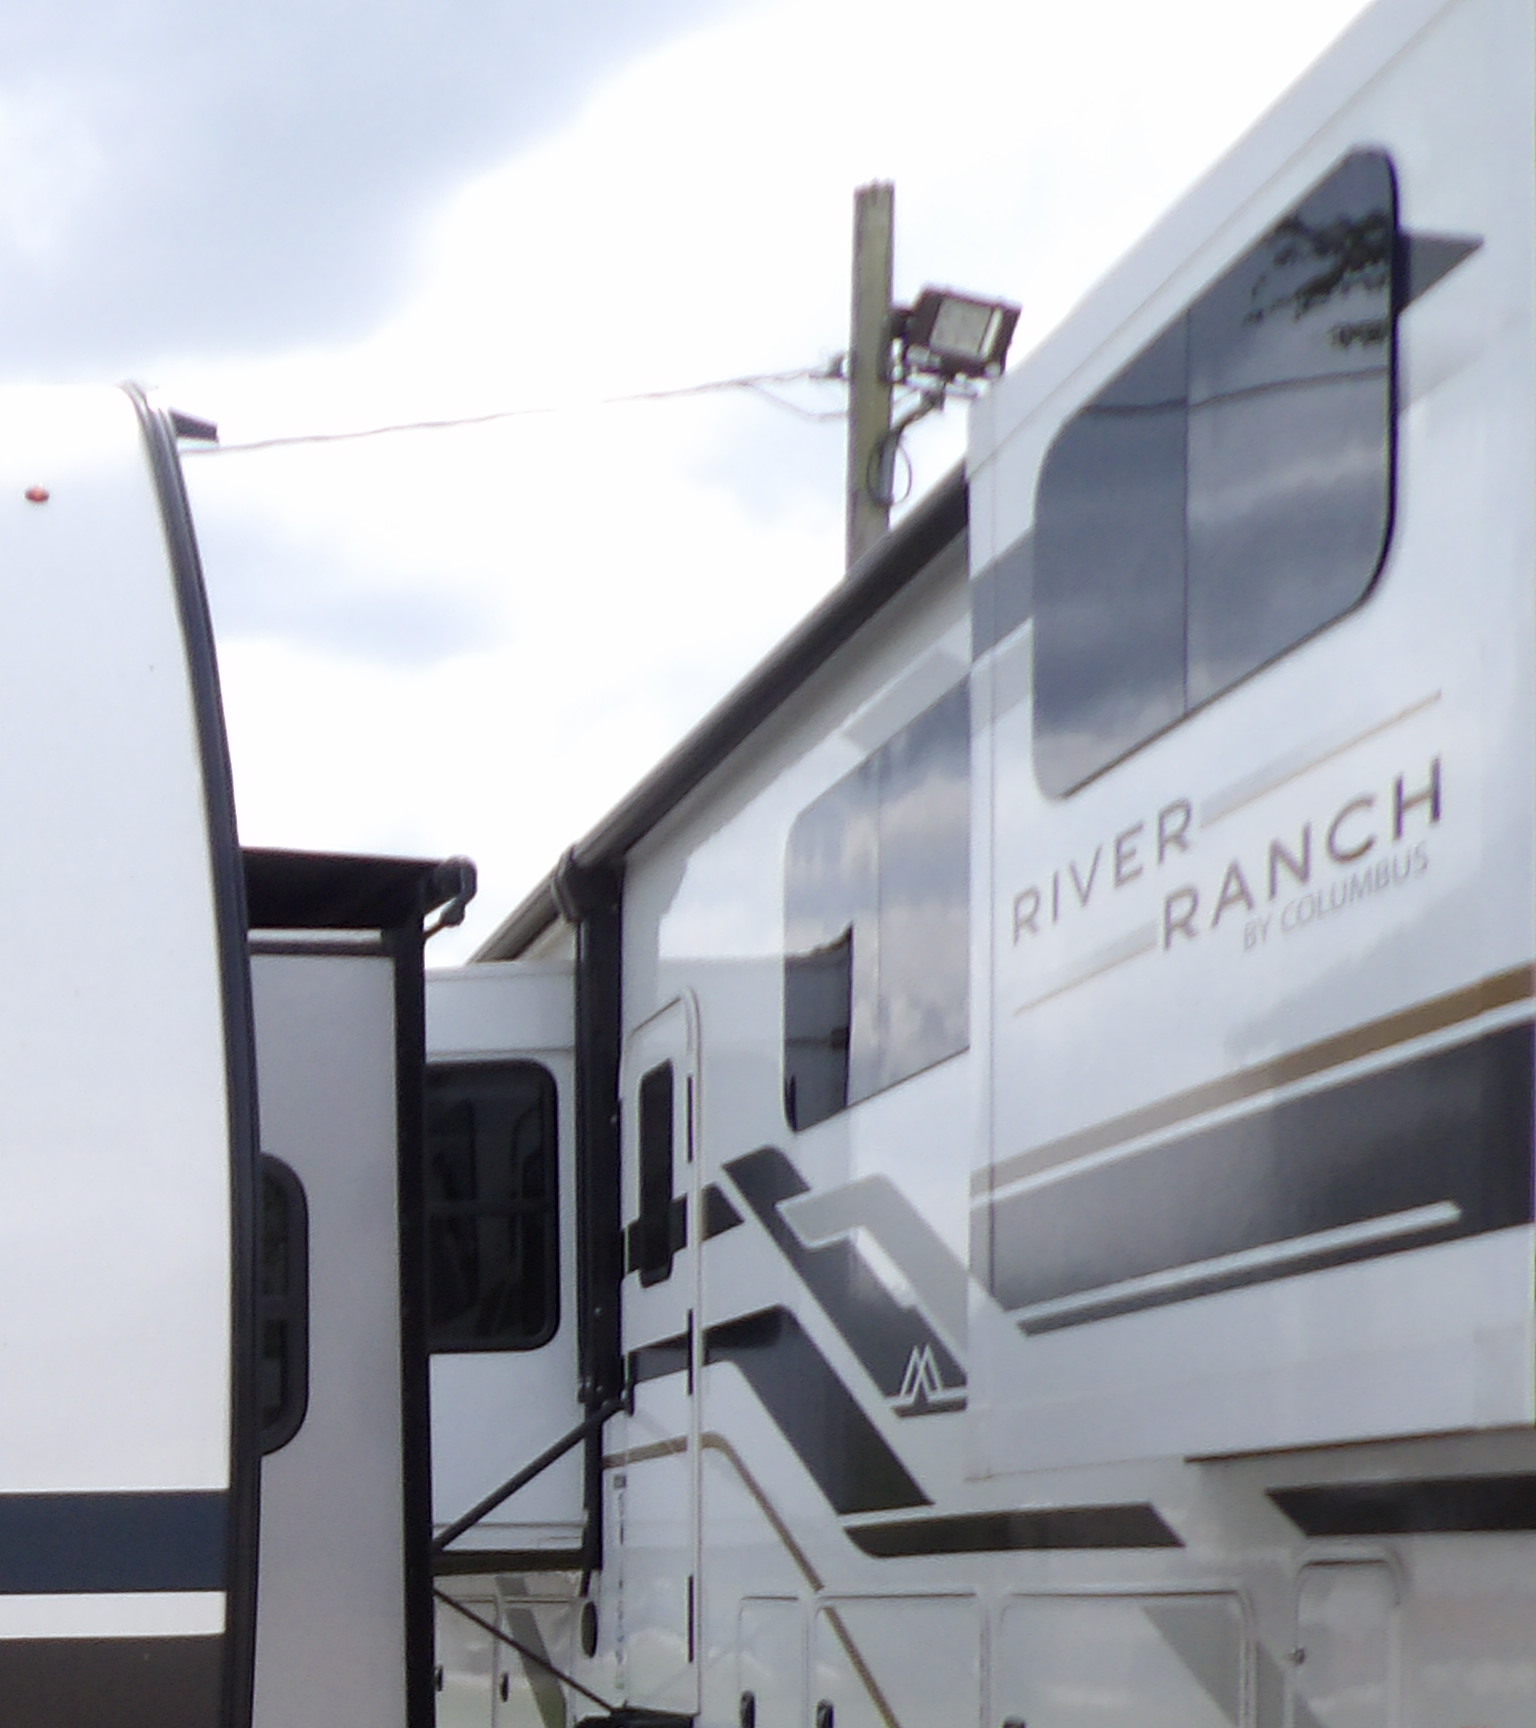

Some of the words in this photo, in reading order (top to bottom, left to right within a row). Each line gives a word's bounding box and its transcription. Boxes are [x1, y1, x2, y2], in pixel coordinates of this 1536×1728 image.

[1012, 797, 1193, 946] RIVER
[1162, 754, 1443, 951] RANCH
[1280, 840, 1429, 933] COLUMBUS
